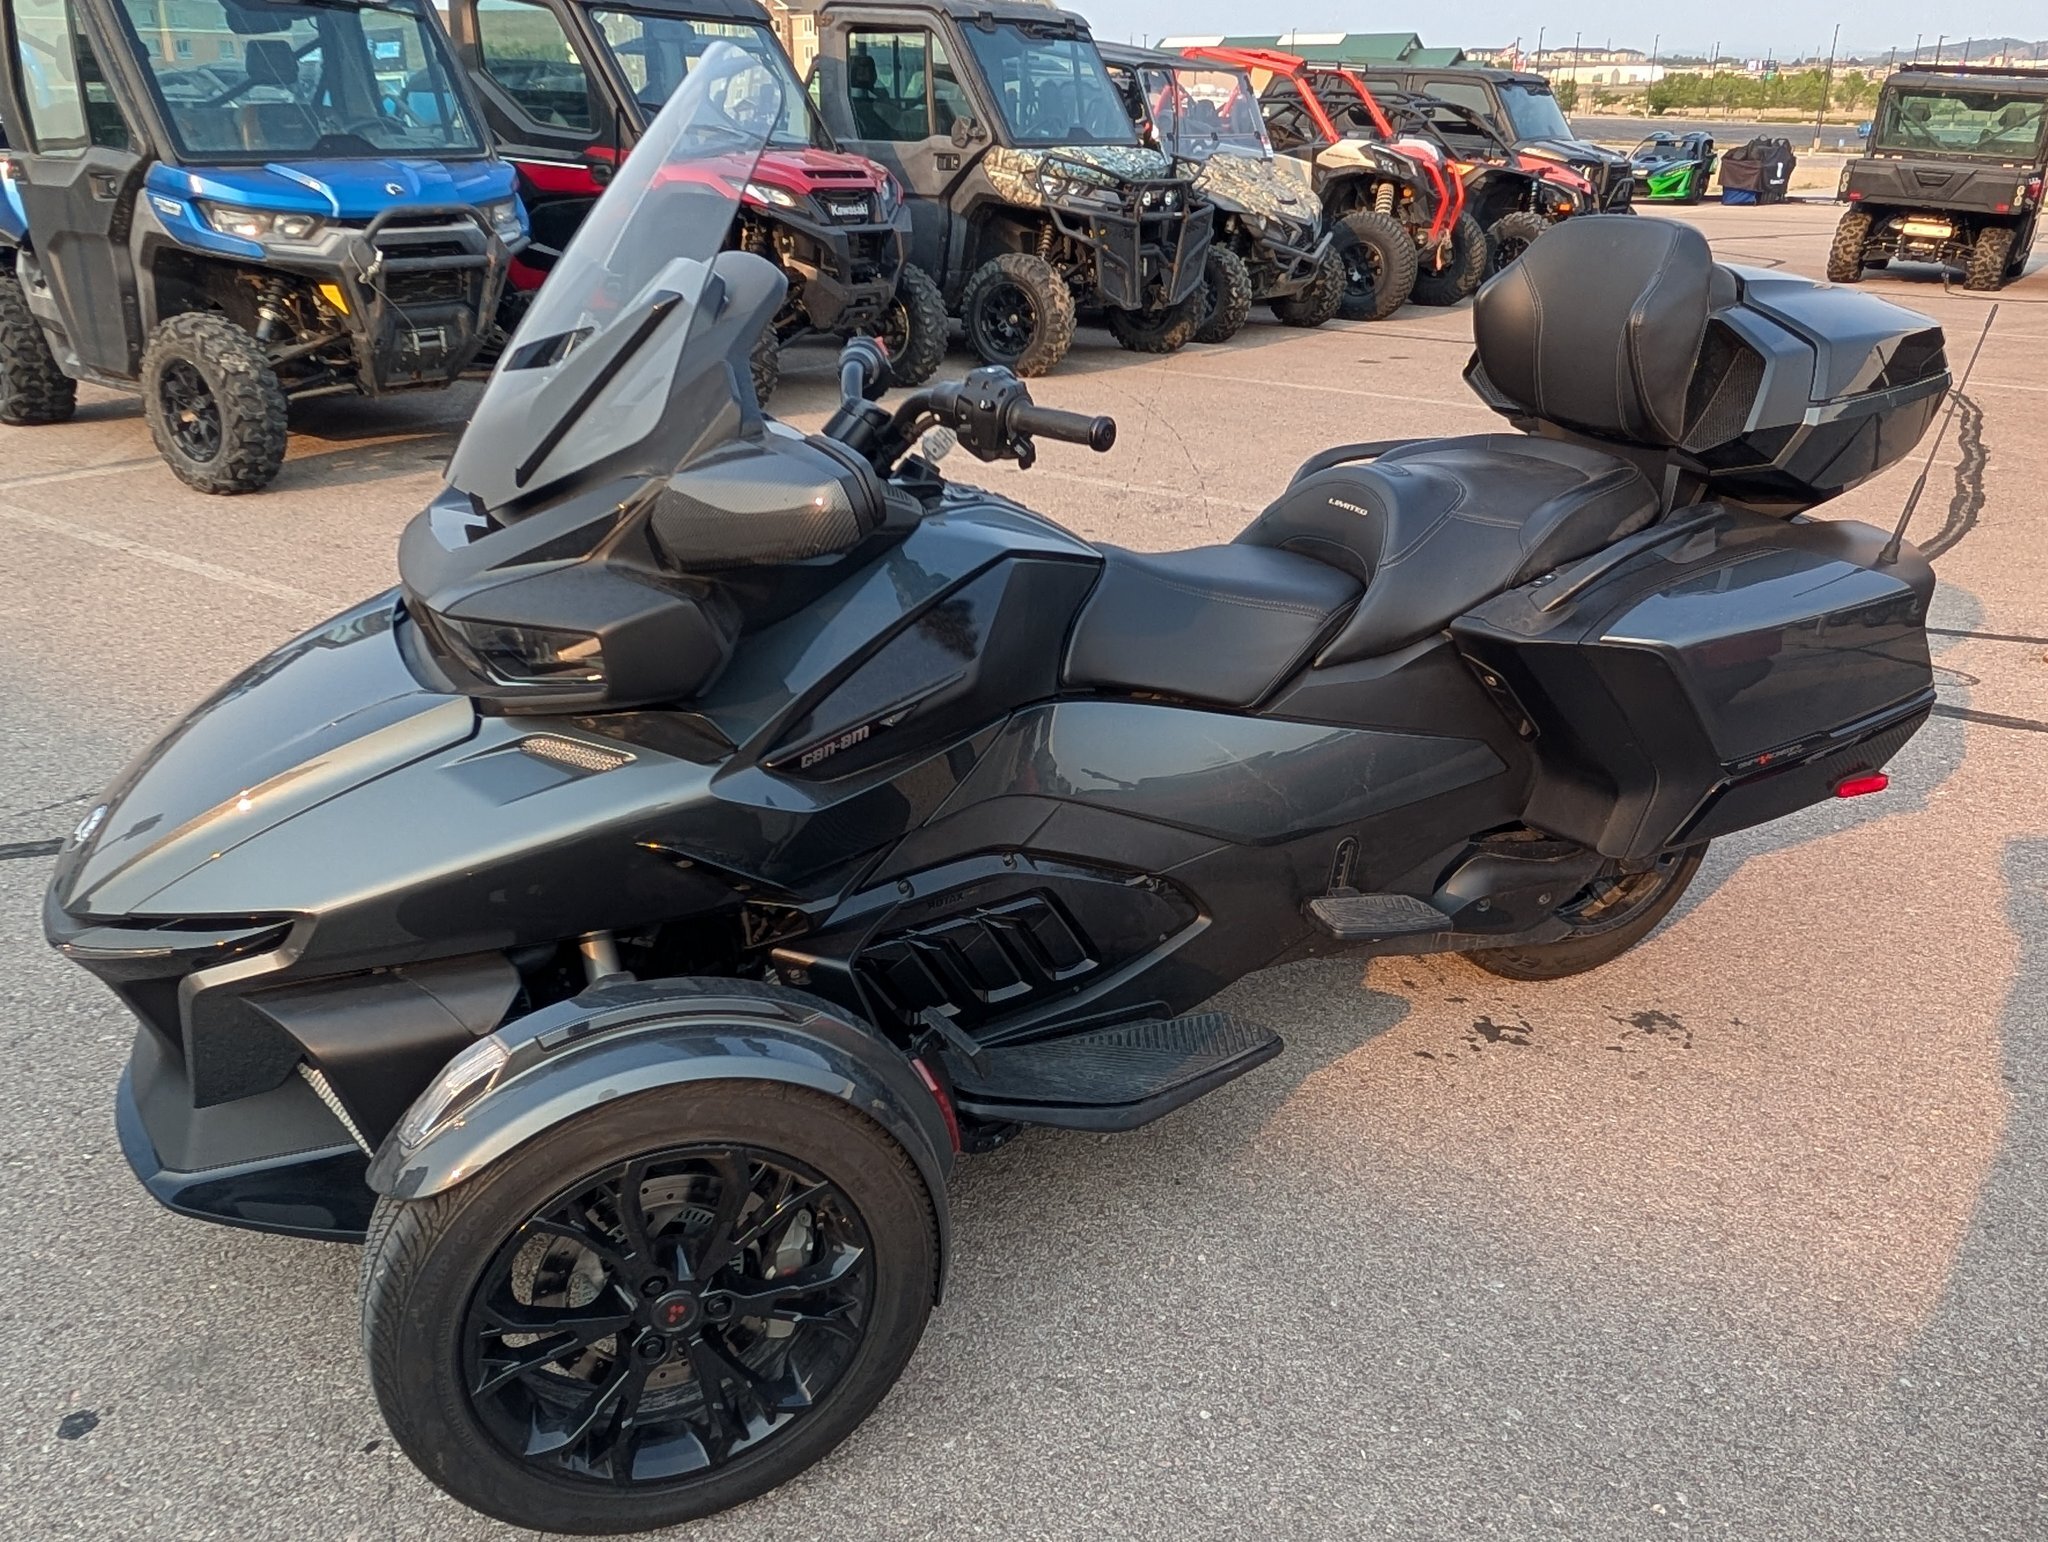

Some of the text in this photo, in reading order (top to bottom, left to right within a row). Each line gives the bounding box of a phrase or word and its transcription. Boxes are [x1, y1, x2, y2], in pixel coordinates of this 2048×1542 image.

[831, 203, 868, 216] Kawasaki
[1328, 498, 1368, 516] LIMITED
[801, 725, 870, 769] can-am
